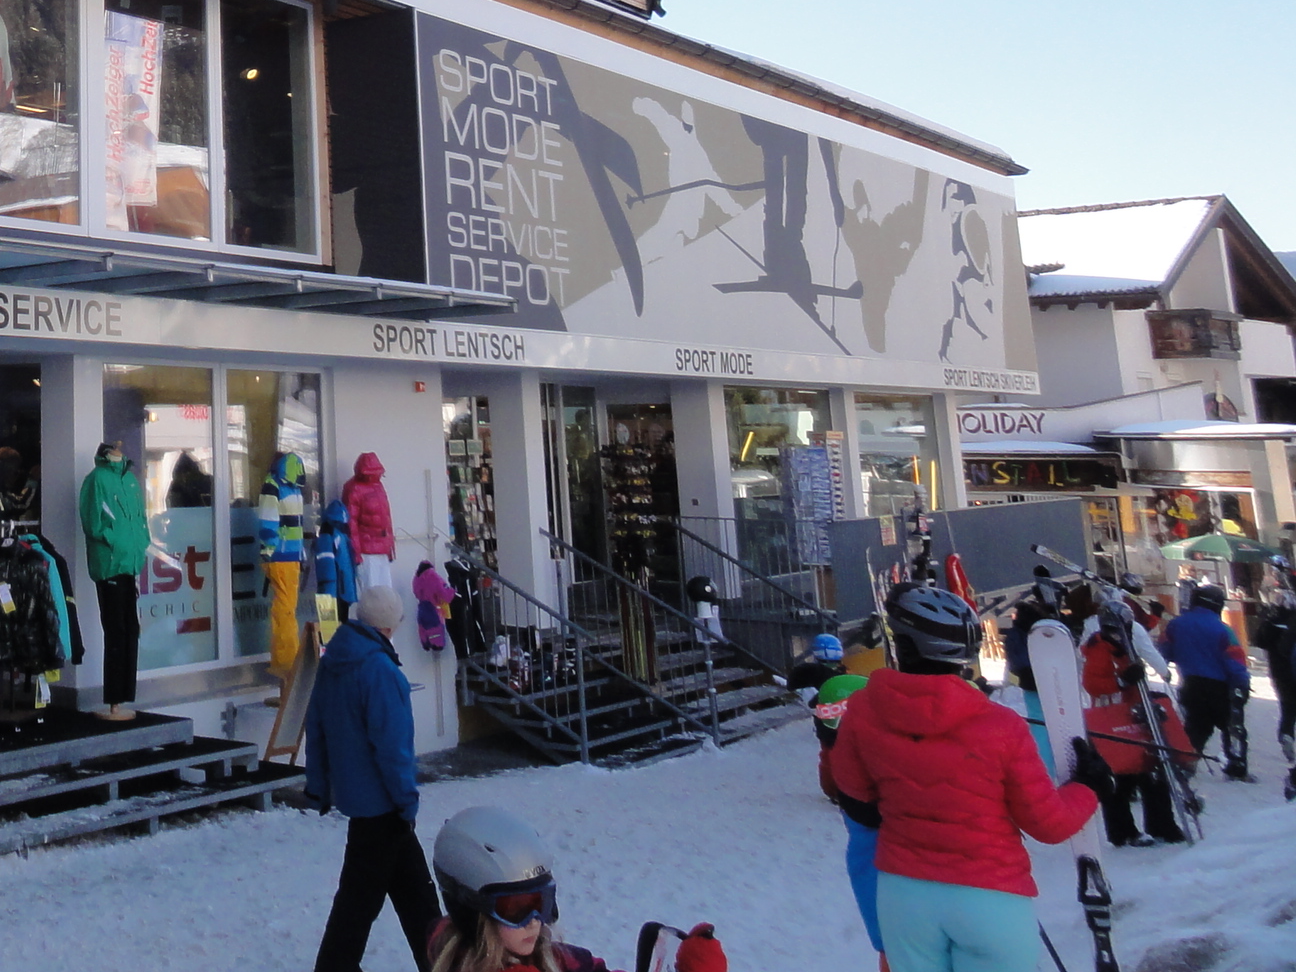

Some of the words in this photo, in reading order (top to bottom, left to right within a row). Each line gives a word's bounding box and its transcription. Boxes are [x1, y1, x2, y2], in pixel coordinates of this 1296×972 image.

[140, 19, 159, 95] HochZei
[439, 48, 557, 115] SPORT
[441, 96, 563, 167] MODE
[444, 150, 563, 221] RENT
[447, 211, 570, 261] SERVICE
[450, 253, 570, 307] DEPOT
[372, 323, 437, 356] SPORT
[443, 328, 525, 361] LENTSCH
[674, 348, 716, 374] SPORT
[720, 351, 754, 375] MODE
[943, 368, 968, 387] SPORT
[969, 369, 999, 390] LENTSCH
